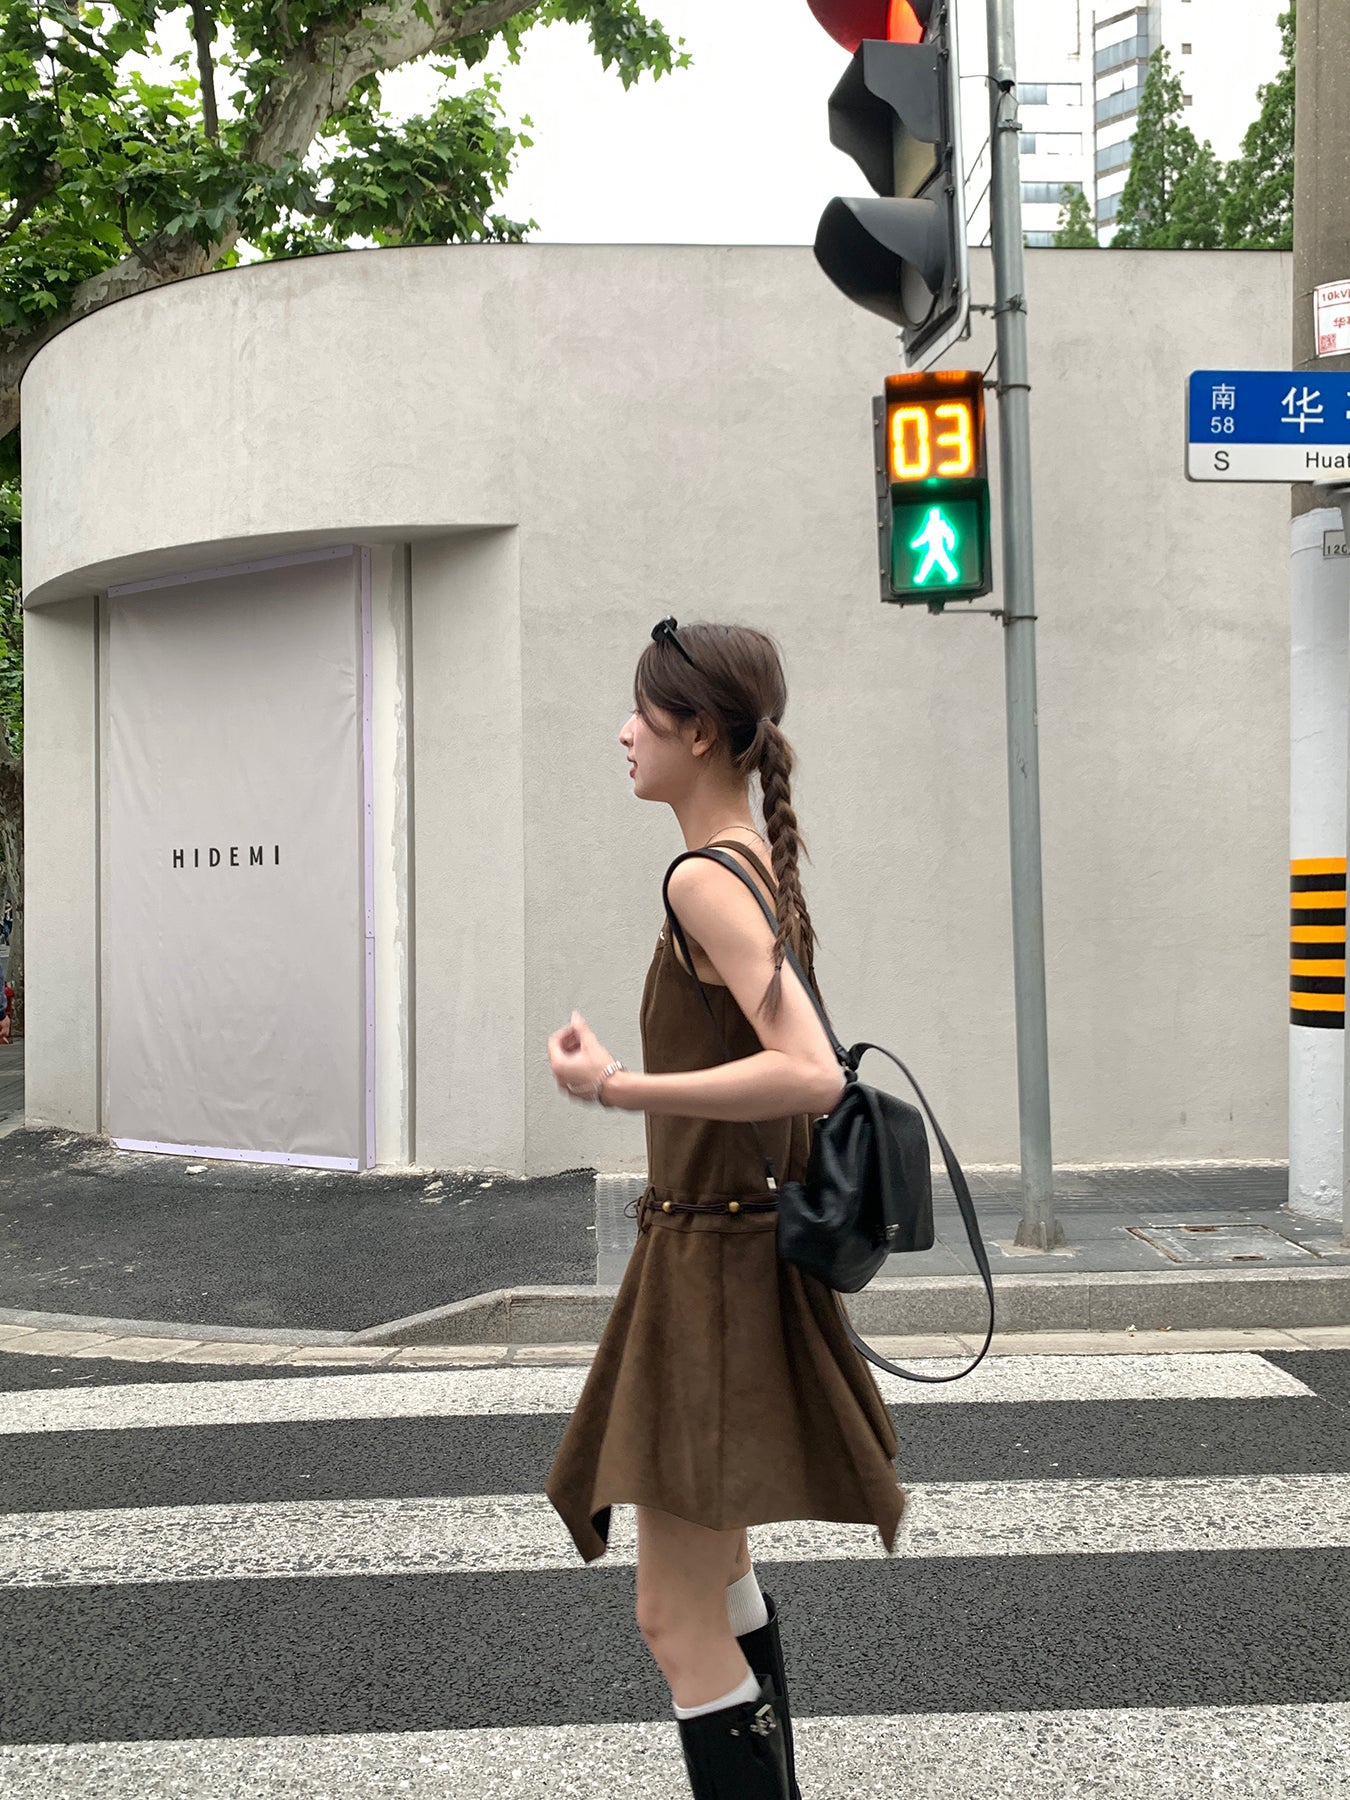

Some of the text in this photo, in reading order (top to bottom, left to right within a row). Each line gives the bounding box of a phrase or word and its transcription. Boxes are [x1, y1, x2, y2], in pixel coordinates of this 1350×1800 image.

[1322, 289, 1350, 301] 10kV
[1211, 383, 1236, 410] 南
[1281, 386, 1350, 433] 华
[1210, 416, 1235, 433] 58
[892, 403, 971, 478] 03
[1213, 450, 1230, 471] S
[173, 845, 279, 868] HIDEMI
